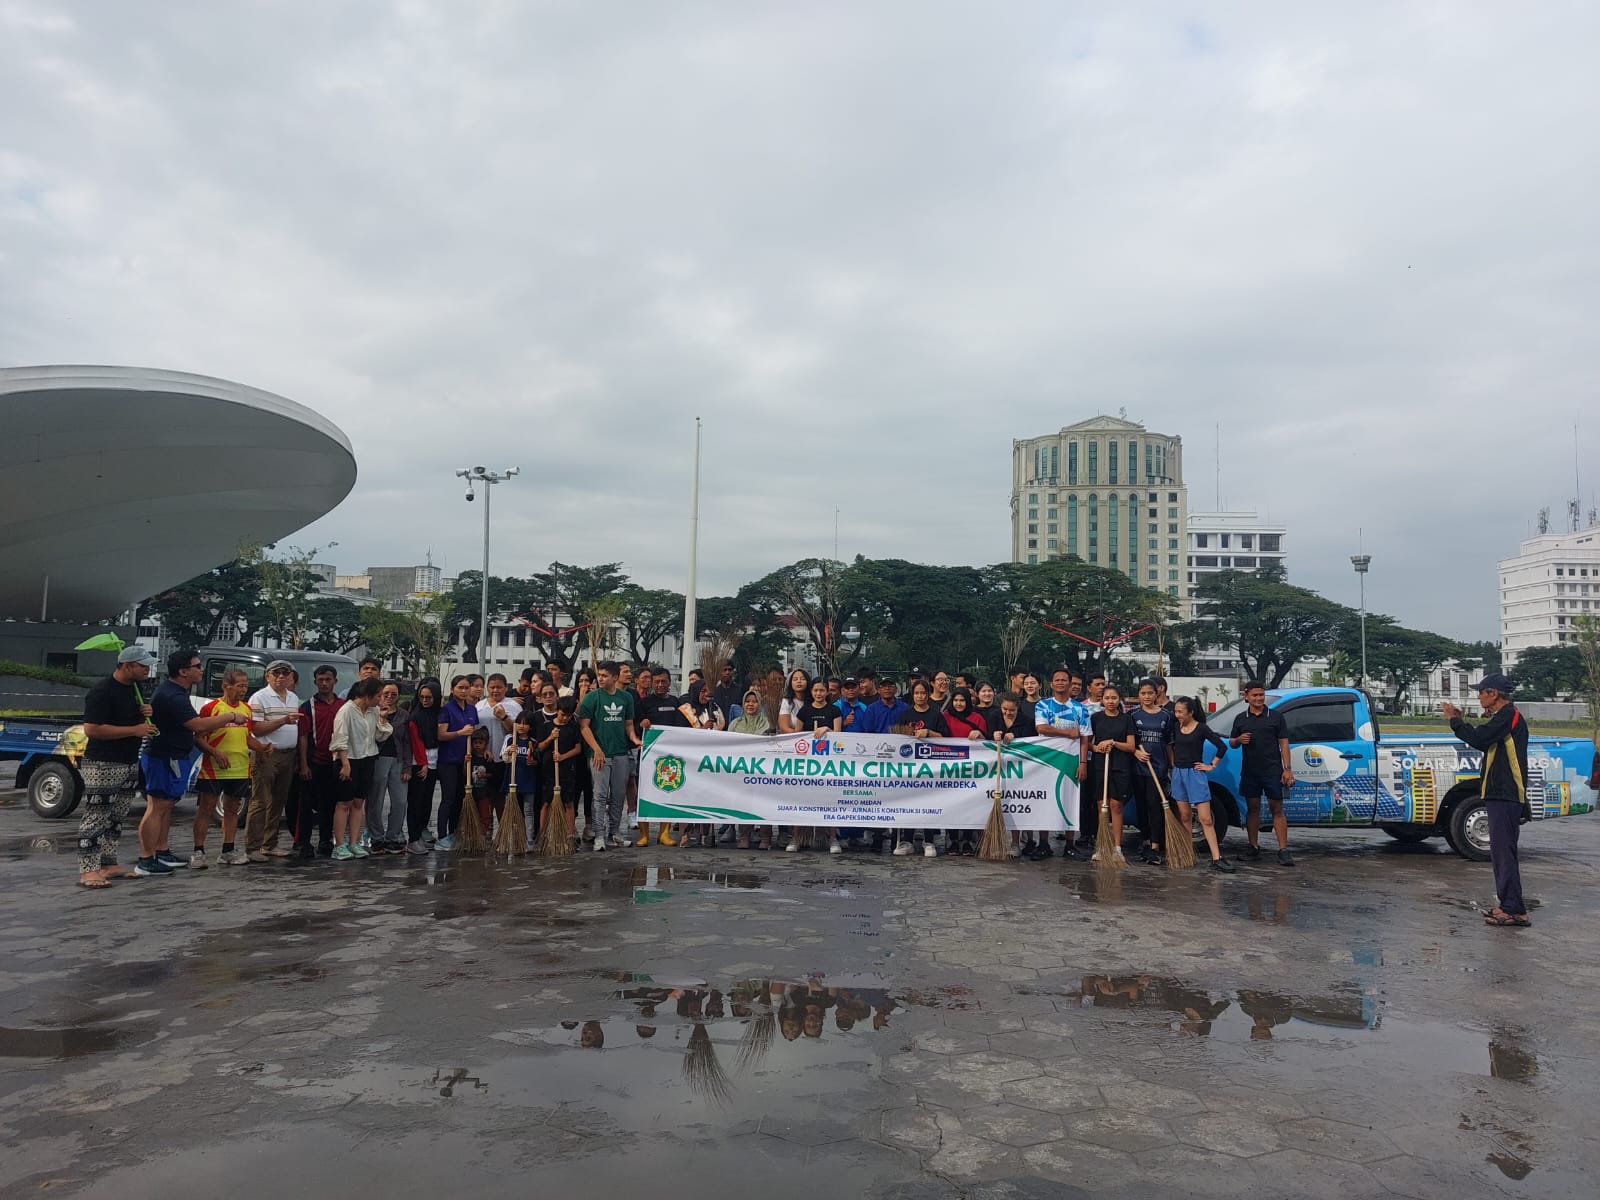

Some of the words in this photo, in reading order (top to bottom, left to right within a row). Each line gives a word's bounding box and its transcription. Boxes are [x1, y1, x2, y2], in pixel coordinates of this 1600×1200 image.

[697, 755, 766, 775] ANAK
[772, 758, 856, 777] MEDAN
[862, 761, 934, 778] CINTA
[940, 761, 1024, 779] MEDAN
[1392, 757, 1446, 770] SOLAR
[1450, 757, 1482, 771] JAY
[743, 776, 783, 785] GOTONG
[785, 778, 824, 787] ROYONG
[826, 779, 881, 788] KEBERSIHAN
[883, 780, 933, 789] LAPANGAN
[935, 780, 977, 789] MERDEKA
[1001, 790, 1047, 800] JANUARI
[1003, 804, 1032, 813] 2026
